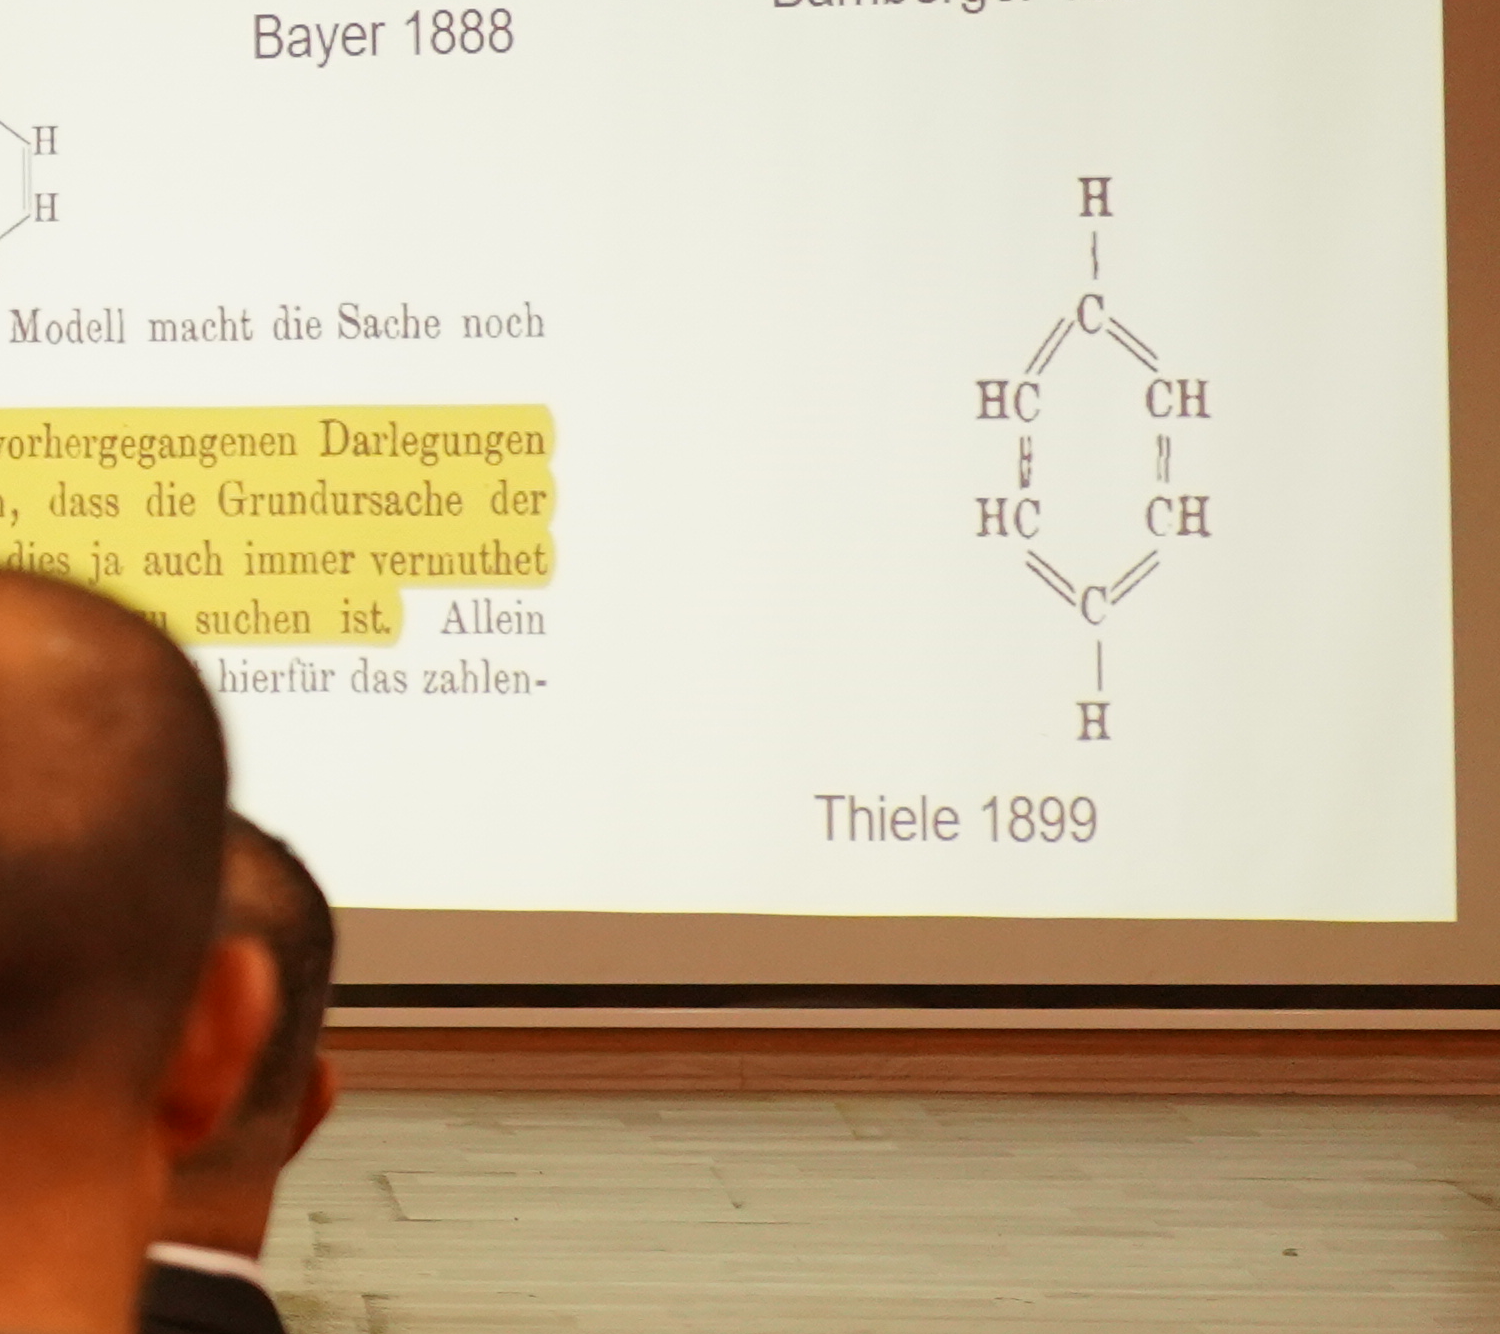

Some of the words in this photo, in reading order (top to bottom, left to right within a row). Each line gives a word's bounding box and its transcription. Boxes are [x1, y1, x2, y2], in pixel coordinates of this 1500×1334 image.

[254, 13, 386, 69] Bayer
[405, 7, 515, 56] 1888
[32, 125, 59, 155] H
[34, 193, 59, 222] H
[1077, 176, 1114, 218] H
[9, 306, 126, 346] Modell
[148, 305, 254, 343] macht
[272, 303, 323, 341] die
[337, 302, 441, 340] Sache
[461, 300, 545, 339] noch
[1076, 292, 1104, 335] C
[975, 379, 1040, 424] HC
[1145, 378, 1212, 419] CH
[317, 417, 549, 467] Darlegungen
[48, 480, 121, 520] dass
[145, 480, 196, 518] die
[217, 478, 464, 518] Grundursache
[489, 478, 550, 517] der
[975, 497, 1041, 540] HC
[1144, 494, 1213, 539] CH
[88, 539, 123, 584] ja
[142, 539, 224, 578] auch
[244, 539, 357, 577] immer
[369, 538, 551, 579] vermuthet
[195, 597, 314, 638] suchen
[339, 597, 393, 637] ist.
[439, 597, 547, 636] Allein
[1081, 586, 1108, 626] C
[217, 657, 336, 696] hierfür
[350, 656, 409, 695] das
[422, 657, 548, 696] zahlen-
[1075, 701, 1111, 742] H
[813, 794, 961, 842] Thiele
[982, 795, 1098, 844] 1899
